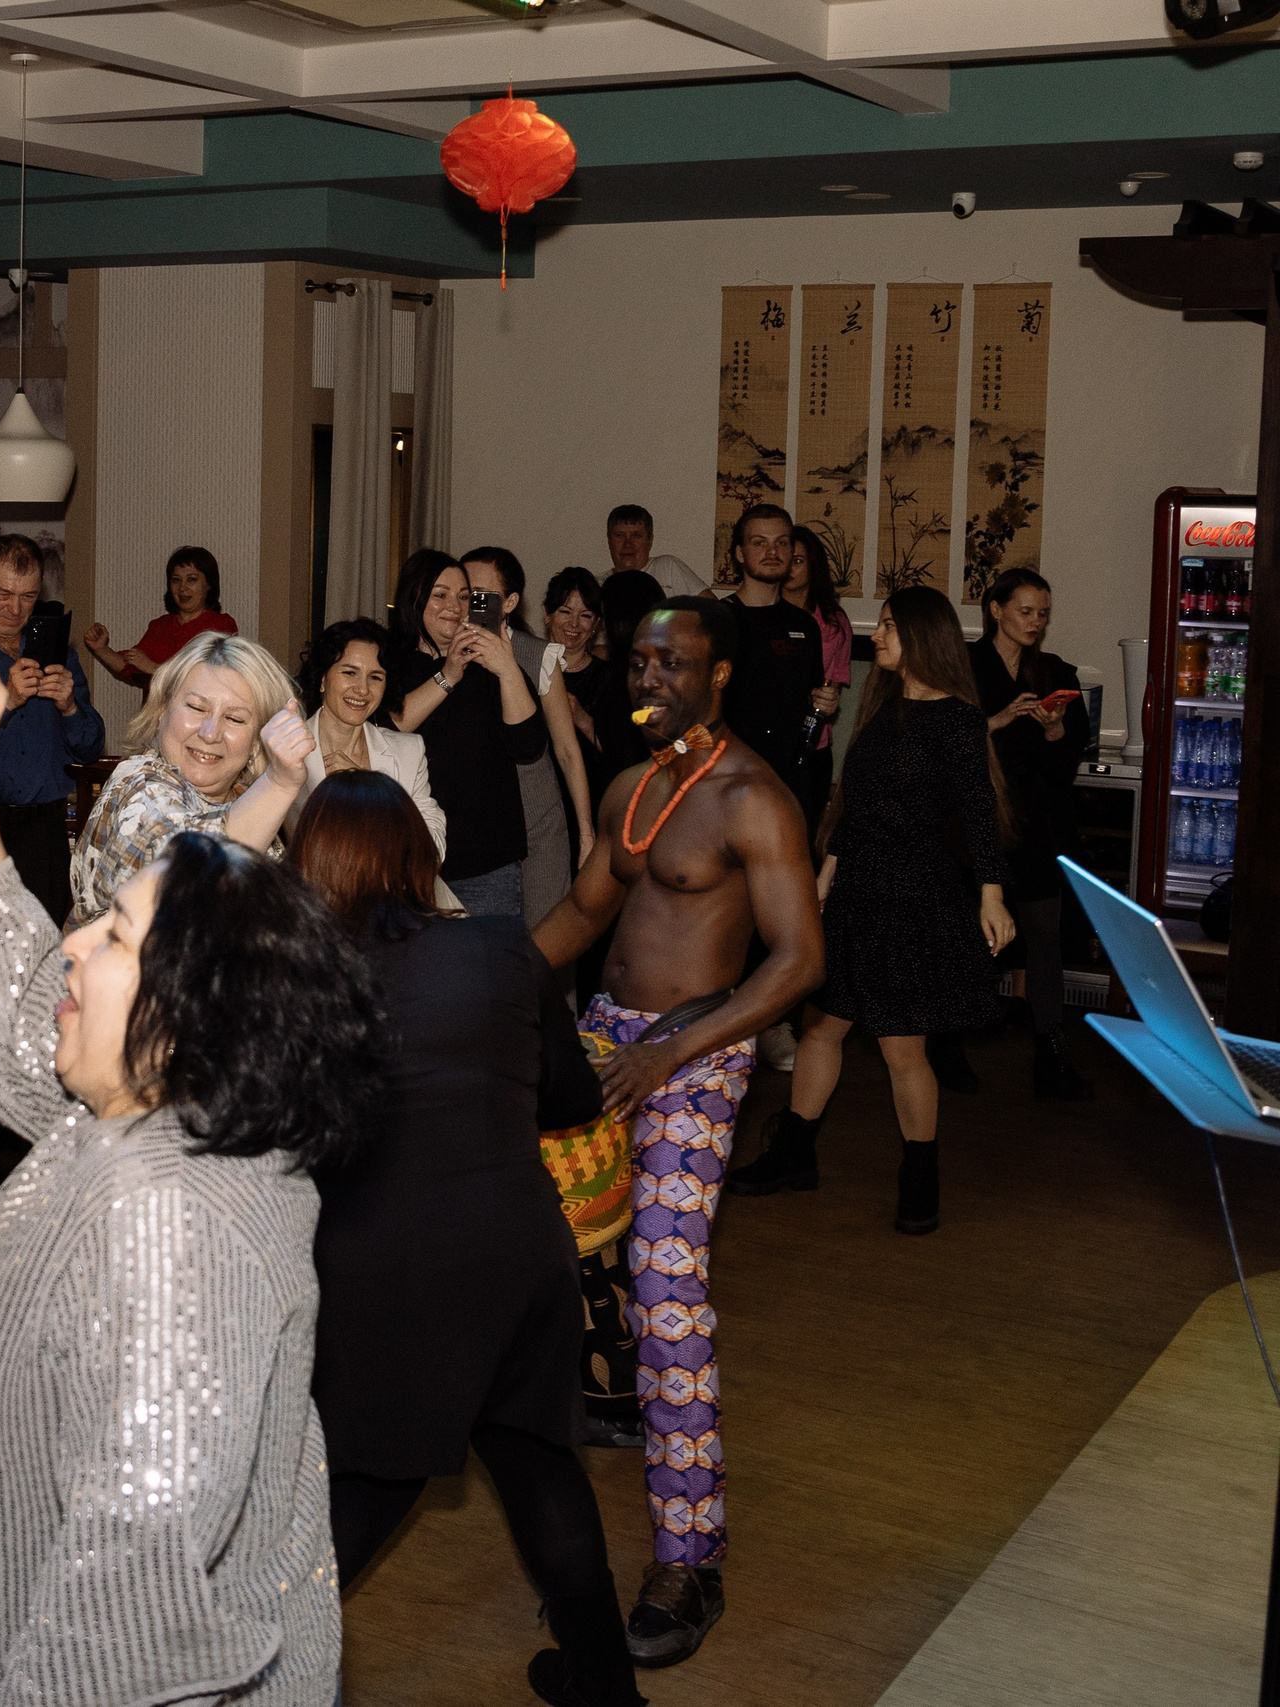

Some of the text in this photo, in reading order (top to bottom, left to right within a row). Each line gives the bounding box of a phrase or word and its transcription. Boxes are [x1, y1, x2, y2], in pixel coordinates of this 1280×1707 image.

[761, 300, 786, 332] 梅
[840, 300, 863, 335] 兰
[929, 300, 957, 334] 竹
[1017, 299, 1045, 335] 菊
